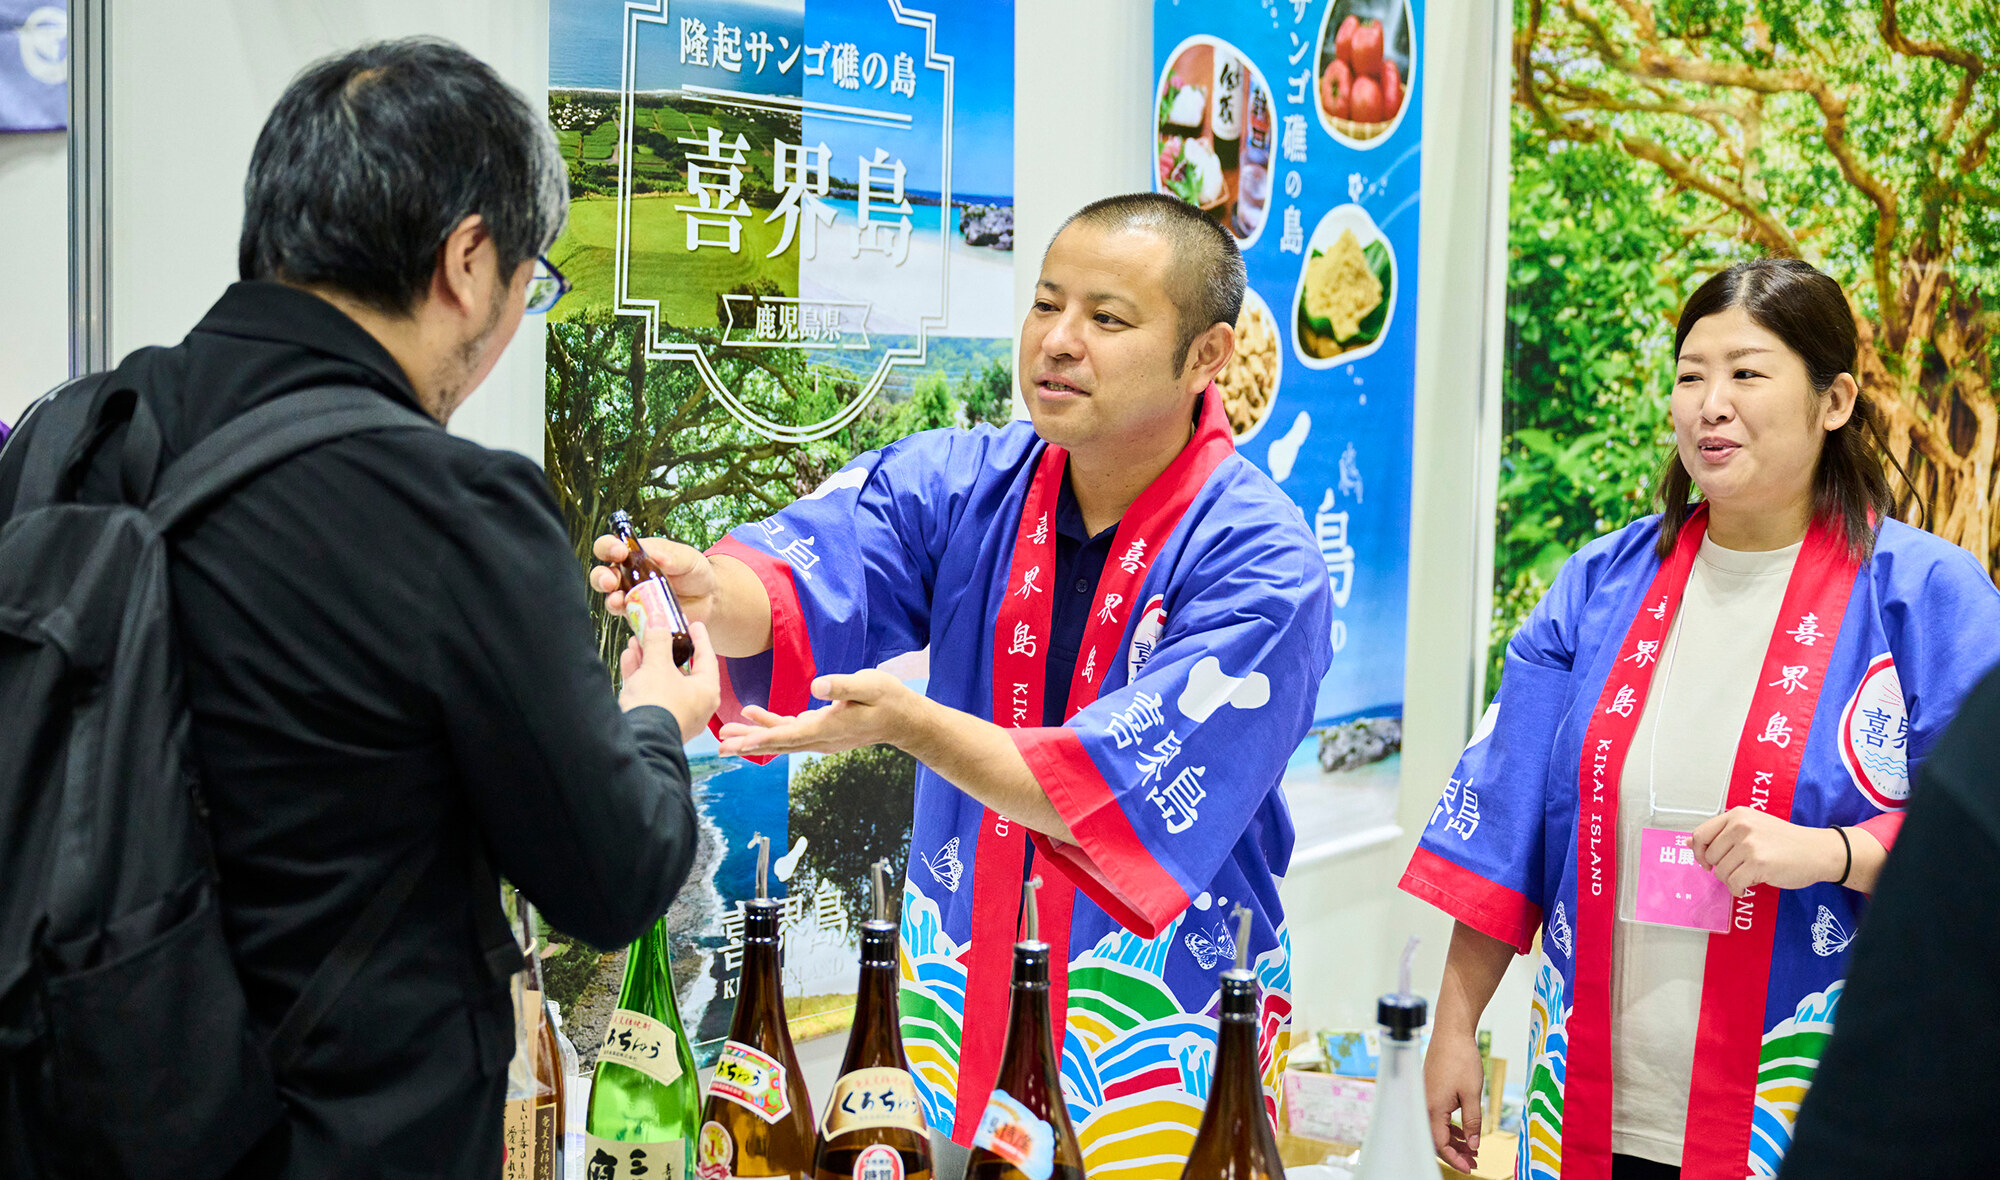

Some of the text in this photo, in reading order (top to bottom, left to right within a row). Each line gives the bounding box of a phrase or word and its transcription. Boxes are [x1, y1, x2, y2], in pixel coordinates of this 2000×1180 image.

[679, 16, 917, 98] 隆起サンゴ礁の島
[674, 126, 914, 268] 喜界島
[754, 304, 842, 342] 鹿児島県
[1007, 511, 1049, 728] 喜界島 KIK
[1081, 537, 1148, 684] 喜界島
[1104, 691, 1207, 835] 喜界島
[1594, 738, 1613, 804] KIKAI
[1734, 612, 1825, 930] 喜界島 KIK AND
[1589, 813, 1604, 897] ISLAND
[1659, 846, 1703, 867] 出展
